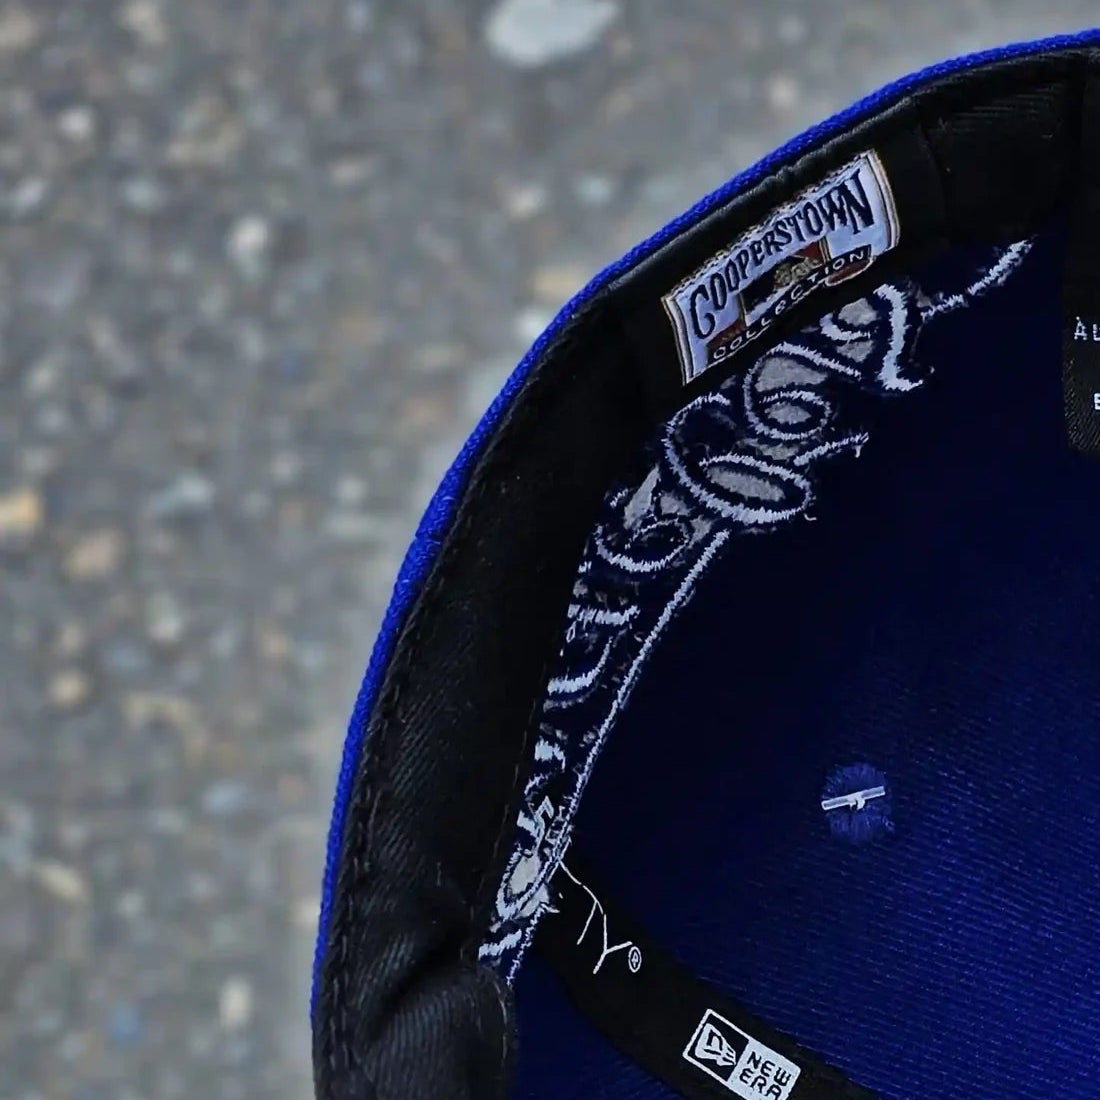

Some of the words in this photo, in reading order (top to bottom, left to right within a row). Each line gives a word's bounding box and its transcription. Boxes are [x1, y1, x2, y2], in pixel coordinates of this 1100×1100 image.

[689, 168, 875, 340] COOPERSTOWN
[713, 248, 866, 361] COLLECTION
[747, 1051, 792, 1087] NEW
